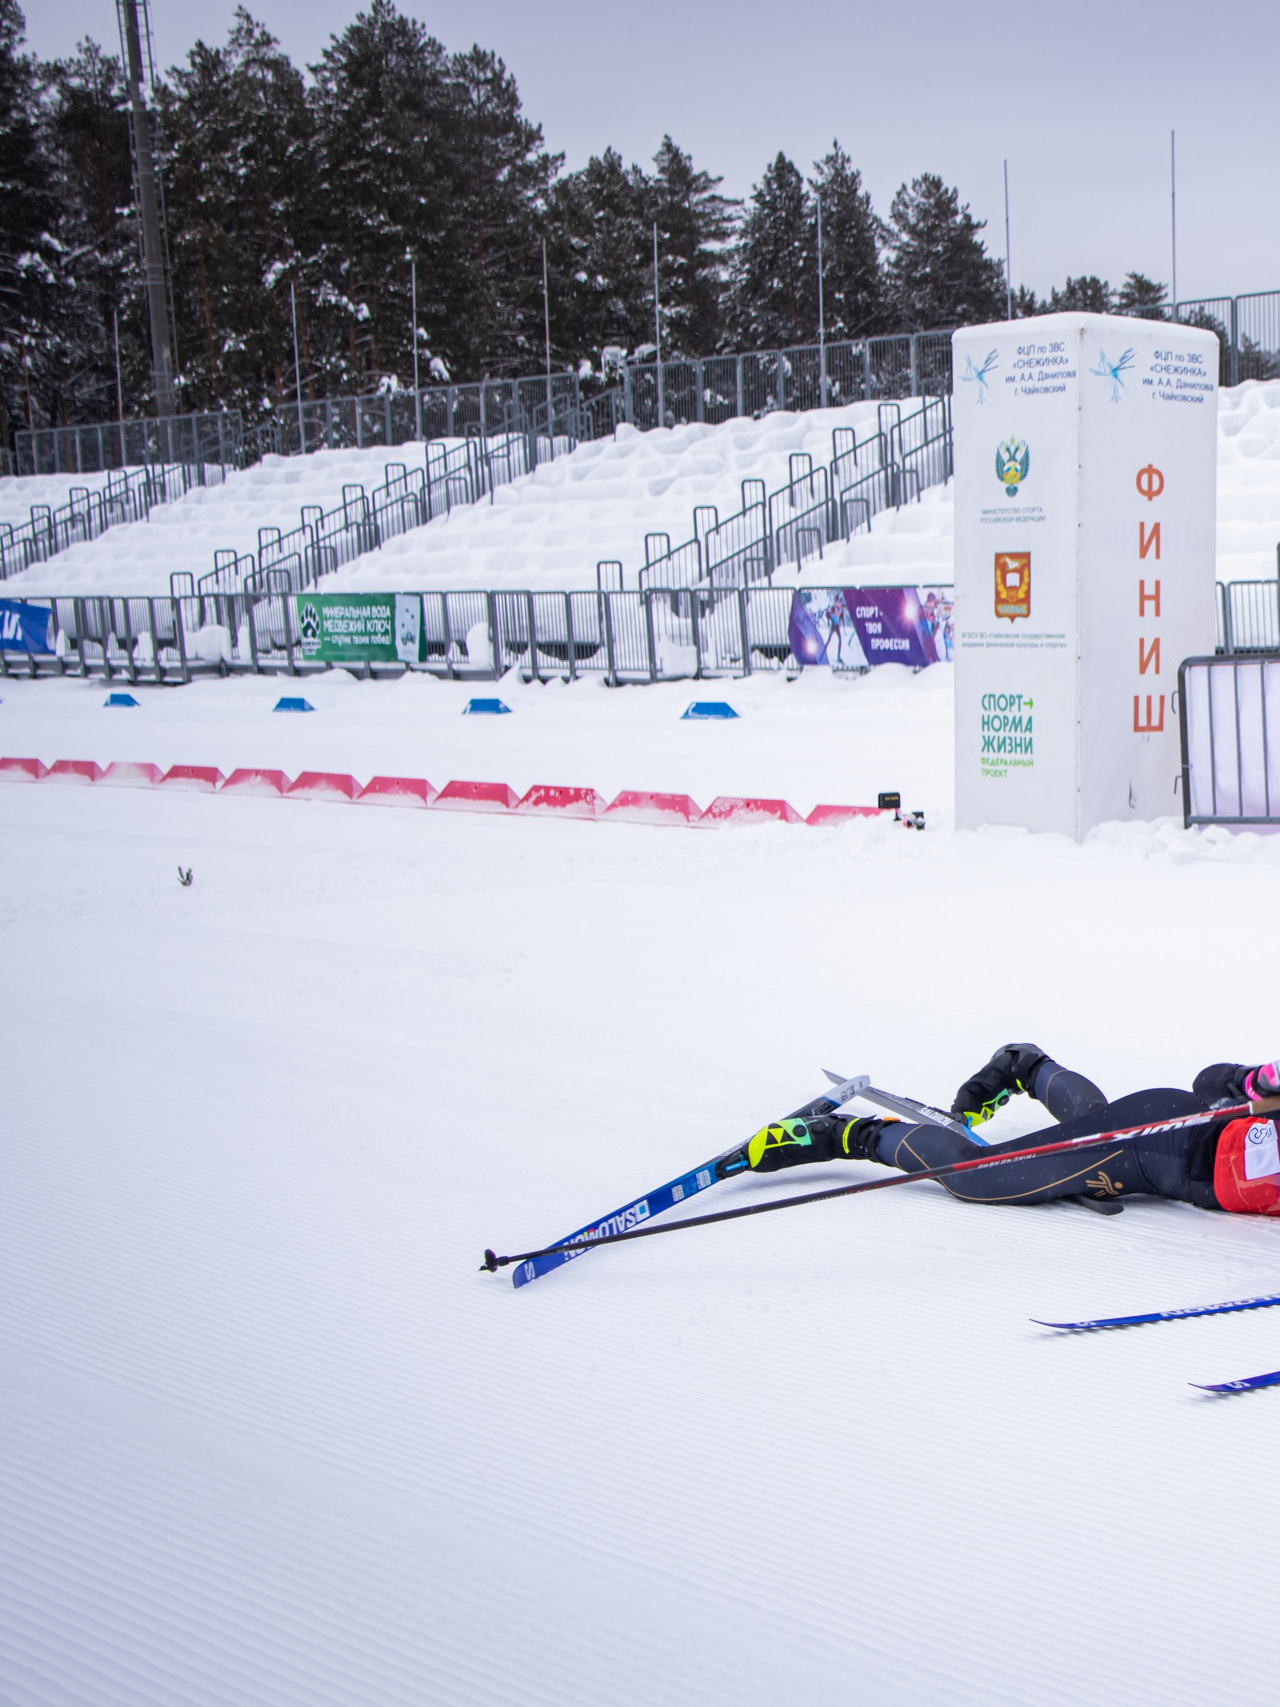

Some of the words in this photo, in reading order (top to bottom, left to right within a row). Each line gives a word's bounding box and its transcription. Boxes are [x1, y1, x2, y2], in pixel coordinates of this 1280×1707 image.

[1016, 345, 1035, 357] ФЦП
[1037, 346, 1047, 355] по
[1153, 350, 1173, 362] ФЦП
[1175, 353, 1185, 362] по
[1012, 356, 1069, 370] «СНЕЖИНКА»
[1150, 362, 1207, 377] «СНЕЖИНКА»
[1037, 370, 1077, 382] Данилова
[1021, 383, 1066, 396] Чайковский
[1175, 379, 1214, 392] Данилова
[1158, 390, 1204, 404] Чайковский
[1133, 463, 1166, 733] ФИНИШ
[371, 605, 391, 618] ВОДА
[855, 606, 879, 619] СПОРТ
[323, 617, 365, 632] МЕДВЕЖИЙ
[366, 619, 391, 633] КЛЮЧ
[865, 622, 882, 634] ТВОЯ
[870, 638, 910, 651] ПРОФЕССИЯ
[981, 693, 1024, 713] СПОРТ
[981, 714, 1033, 734] НОРМА
[981, 735, 1033, 755] ЖИЗНИ
[980, 757, 1034, 768] ФЕДЕРАЛЬНЫЙ
[981, 768, 1008, 778] ПРОЕКТ
